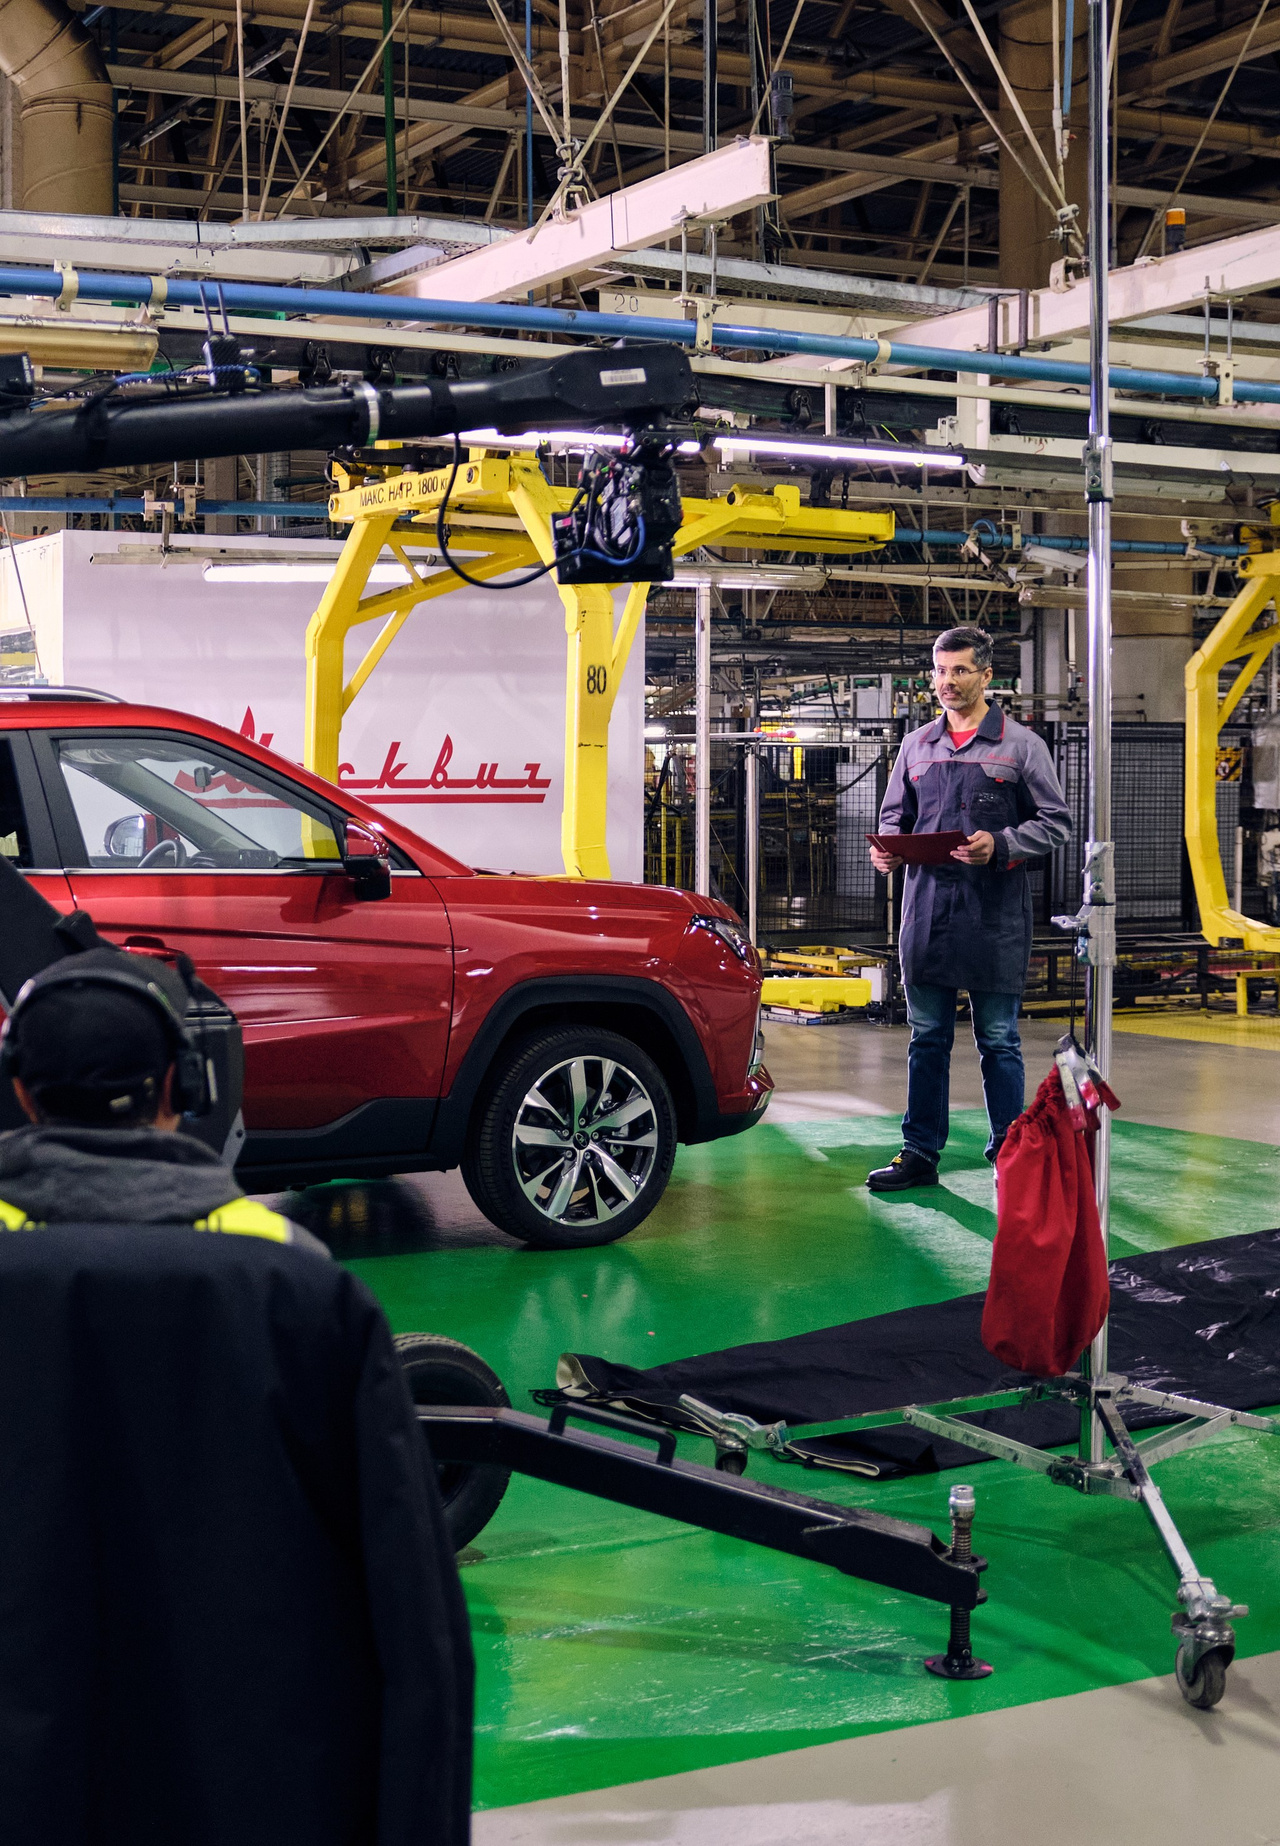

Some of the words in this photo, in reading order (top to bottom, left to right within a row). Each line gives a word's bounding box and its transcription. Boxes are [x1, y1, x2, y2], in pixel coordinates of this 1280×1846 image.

[614, 293, 639, 313] 20
[360, 486, 386, 508] МАКС.
[389, 481, 414, 501] НАГР.
[418, 476, 438, 495] 1800
[586, 664, 607, 695] 80
